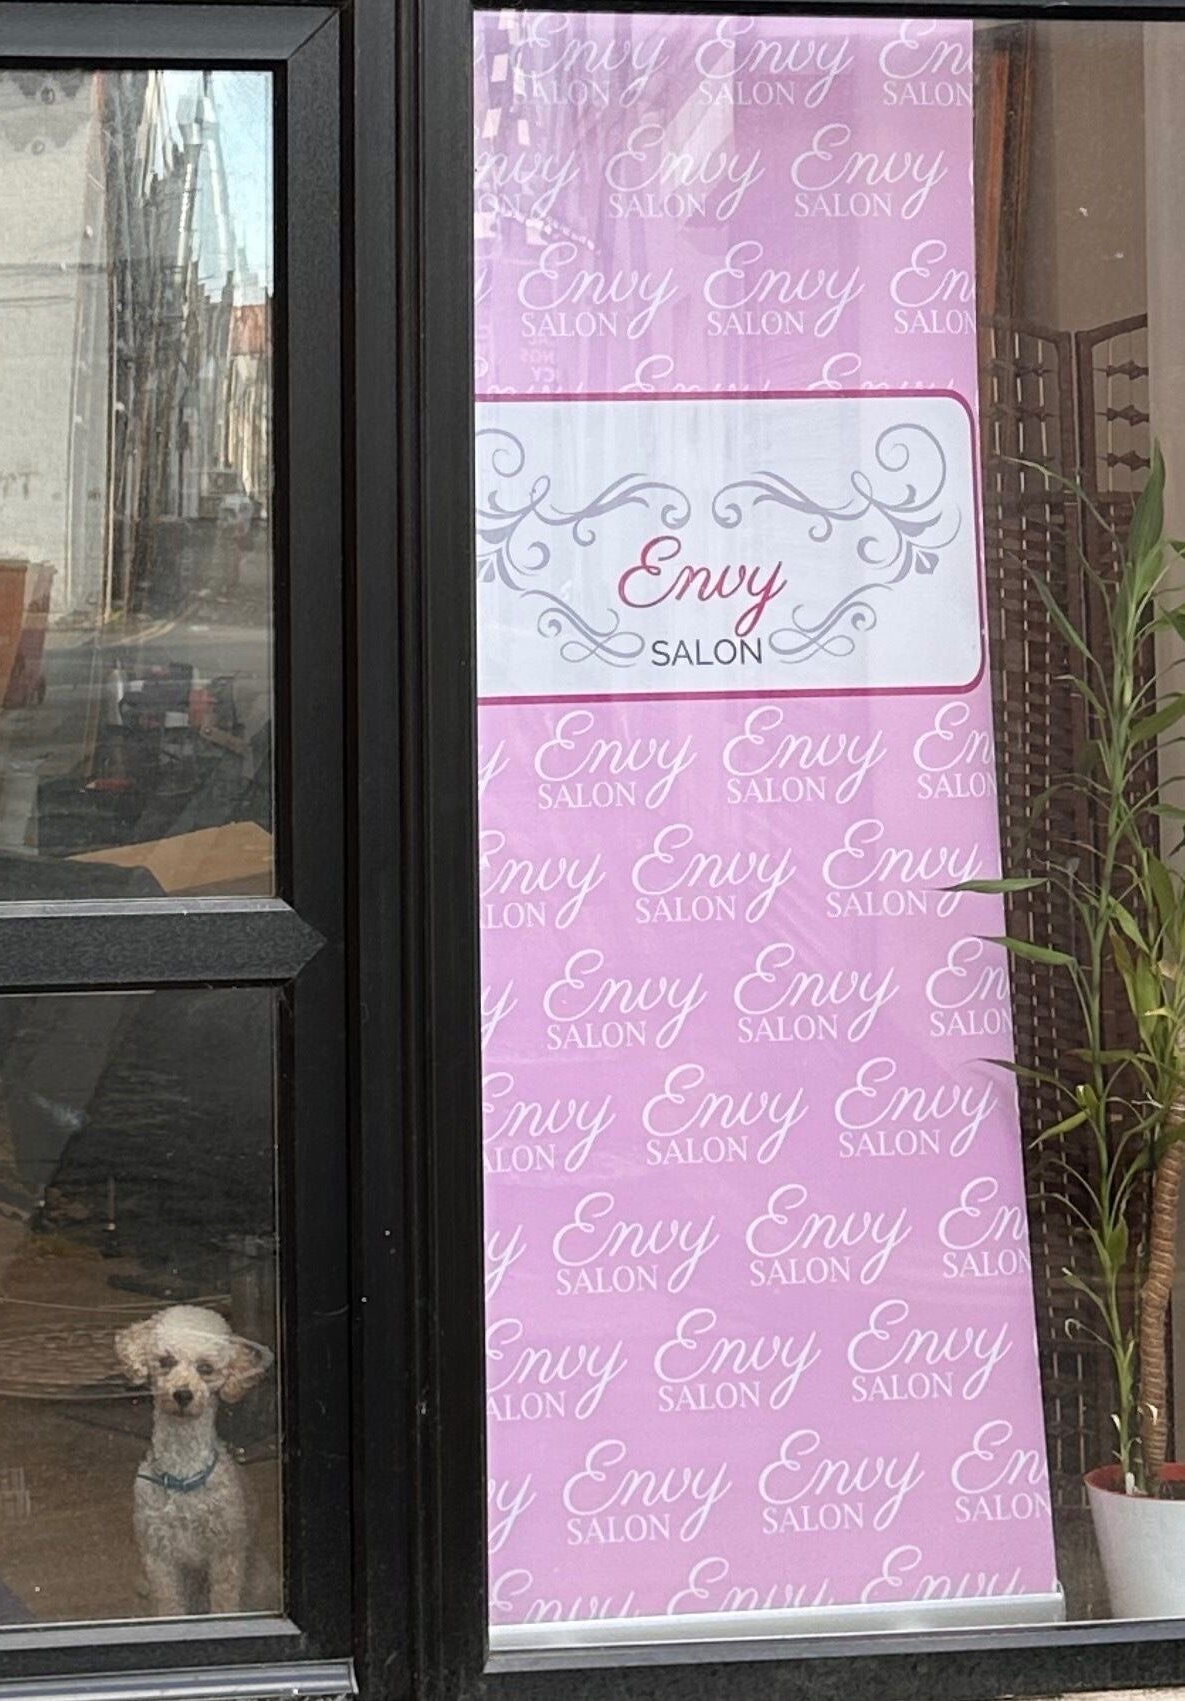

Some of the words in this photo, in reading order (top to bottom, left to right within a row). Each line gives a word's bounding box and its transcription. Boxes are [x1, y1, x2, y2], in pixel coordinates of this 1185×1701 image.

[695, 16, 853, 108] Envy
[879, 19, 973, 79] En
[697, 80, 796, 106] SALON
[883, 80, 973, 106] SALON
[605, 124, 766, 221] Envy
[791, 123, 948, 220] Envy
[609, 192, 707, 219] SALON
[794, 192, 893, 218] SALON
[517, 240, 679, 339] Envy
[703, 240, 865, 338] Envy
[890, 239, 976, 308] En
[521, 311, 617, 338] SALON
[706, 310, 804, 336] SALON
[618, 535, 788, 638] Envy
[651, 638, 764, 667] SALON
[534, 709, 697, 810] Envy
[722, 705, 887, 804] Envy
[537, 781, 637, 810] SALON
[726, 776, 827, 804] SALON
[631, 823, 797, 924] Envy
[822, 818, 987, 918] Envy
[635, 895, 737, 924] SALON
[826, 889, 928, 918] SALON
[543, 948, 708, 1050] Envy
[733, 942, 900, 1043] Envy
[546, 1021, 648, 1051] SALON
[737, 1014, 839, 1043] SALON
[642, 1063, 808, 1165] Envy
[834, 1057, 999, 1158] Envy
[645, 1136, 749, 1166] SALON
[838, 1128, 942, 1159] SALON
[552, 1191, 720, 1294] Envy
[745, 1183, 912, 1285] Envy
[938, 1176, 1029, 1250] En
[555, 1264, 659, 1296] SALON
[749, 1255, 852, 1287] SALON
[653, 1308, 821, 1411] Envy
[847, 1298, 1013, 1400] Envy
[658, 1381, 761, 1413] SALON
[851, 1372, 955, 1403] SALON
[562, 1439, 733, 1542] Envy
[758, 1429, 926, 1531] Envy
[950, 1419, 1049, 1494] En
[566, 1513, 671, 1546] SALON
[762, 1502, 865, 1535] SALON
